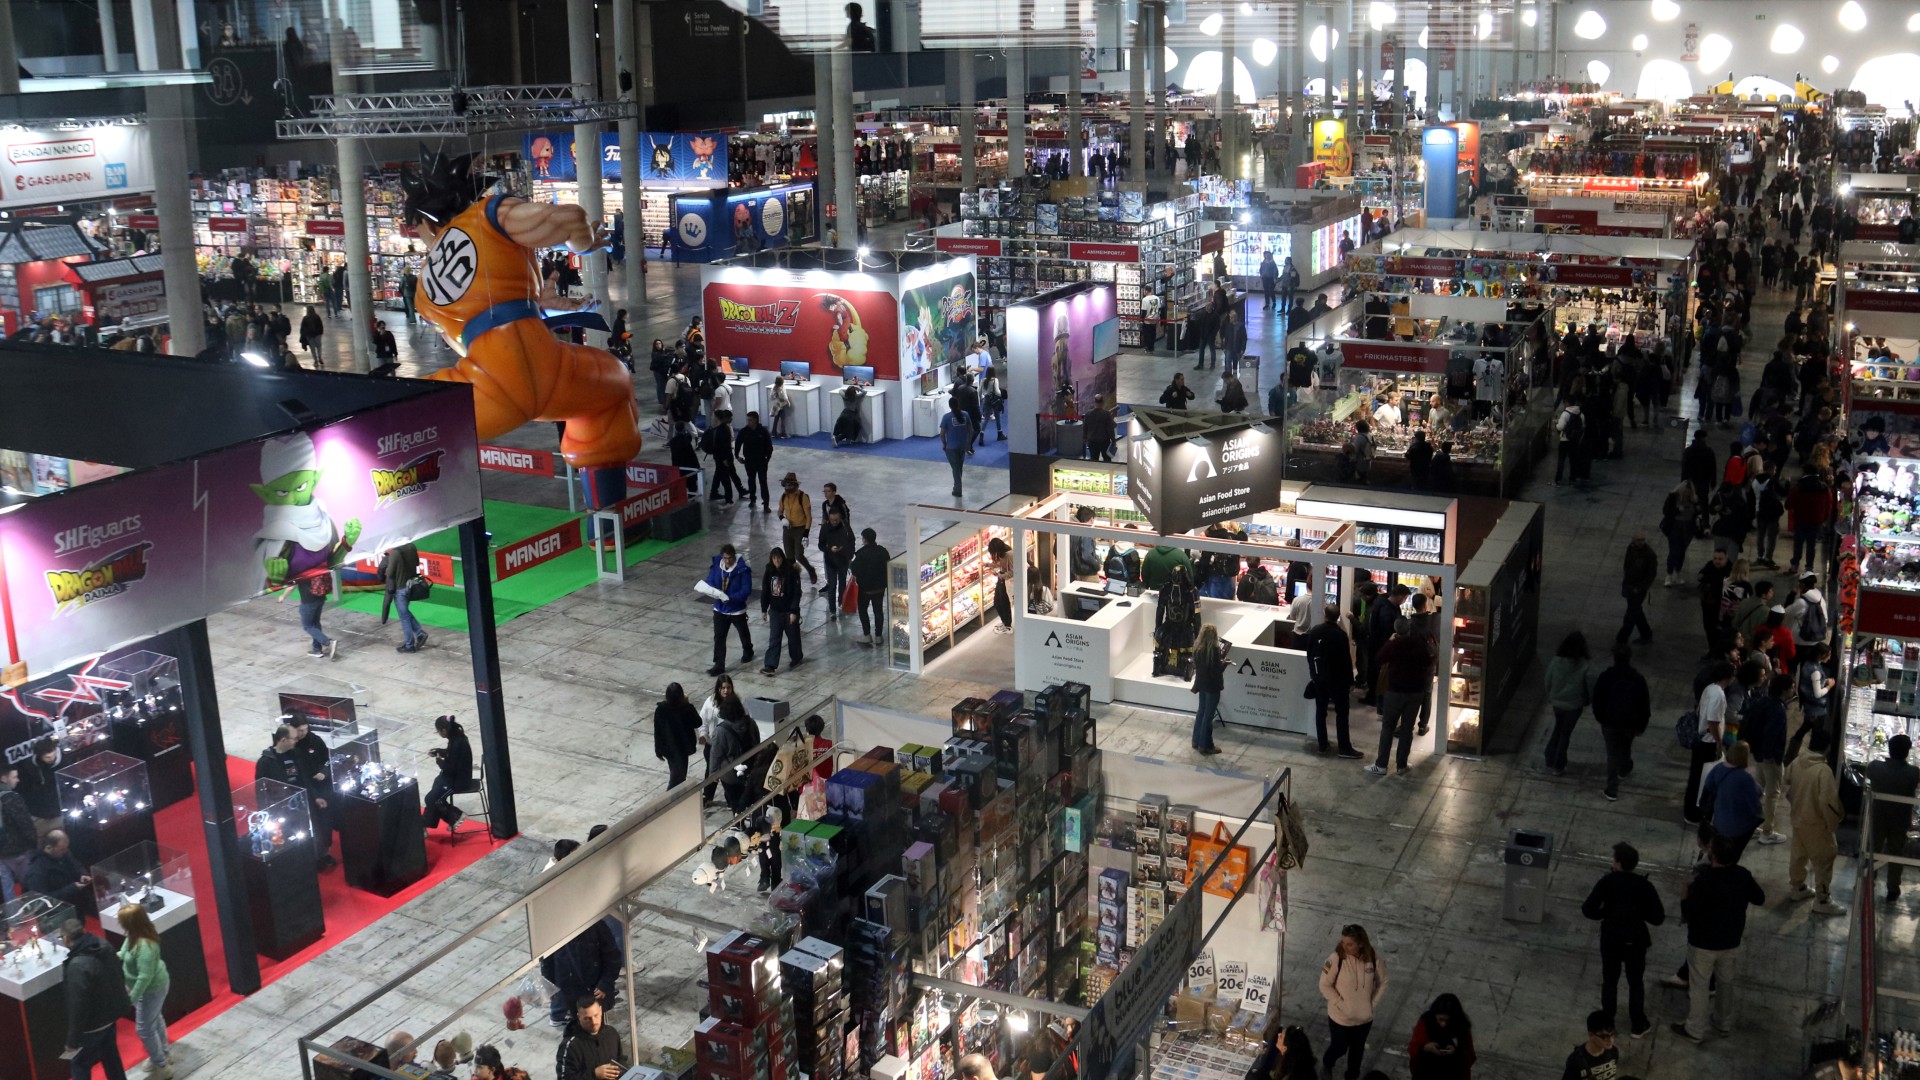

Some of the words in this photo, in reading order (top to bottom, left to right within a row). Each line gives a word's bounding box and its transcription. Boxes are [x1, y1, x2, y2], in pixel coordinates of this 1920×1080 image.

[52, 143, 91, 155] NAMCO
[27, 172, 91, 187] GASHAPON
[775, 300, 801, 327] Z
[1364, 353, 1429, 363] FRIKIMASTERS.ES
[1222, 437, 1251, 452] ASIAN
[480, 448, 534, 470] MANGA
[1222, 445, 1260, 463] ORIGINS
[1199, 494, 1216, 505] Asian
[1217, 490, 1233, 500] Food
[1234, 486, 1250, 496] Store
[623, 488, 671, 522] MANGA
[1201, 502, 1246, 519] asianorigins.es
[505, 532, 560, 571] MANGA
[47, 564, 114, 604] DRAGON
[1065, 638, 1090, 647] ORIGINS
[1260, 660, 1280, 668] ASIAN
[1260, 666, 1287, 675] ORIGINS
[1153, 919, 1178, 963] star
[1190, 965, 1213, 978] 30€
[1114, 966, 1142, 1011] blue
[1218, 978, 1244, 990] 20€
[1245, 987, 1267, 1004] 10€
